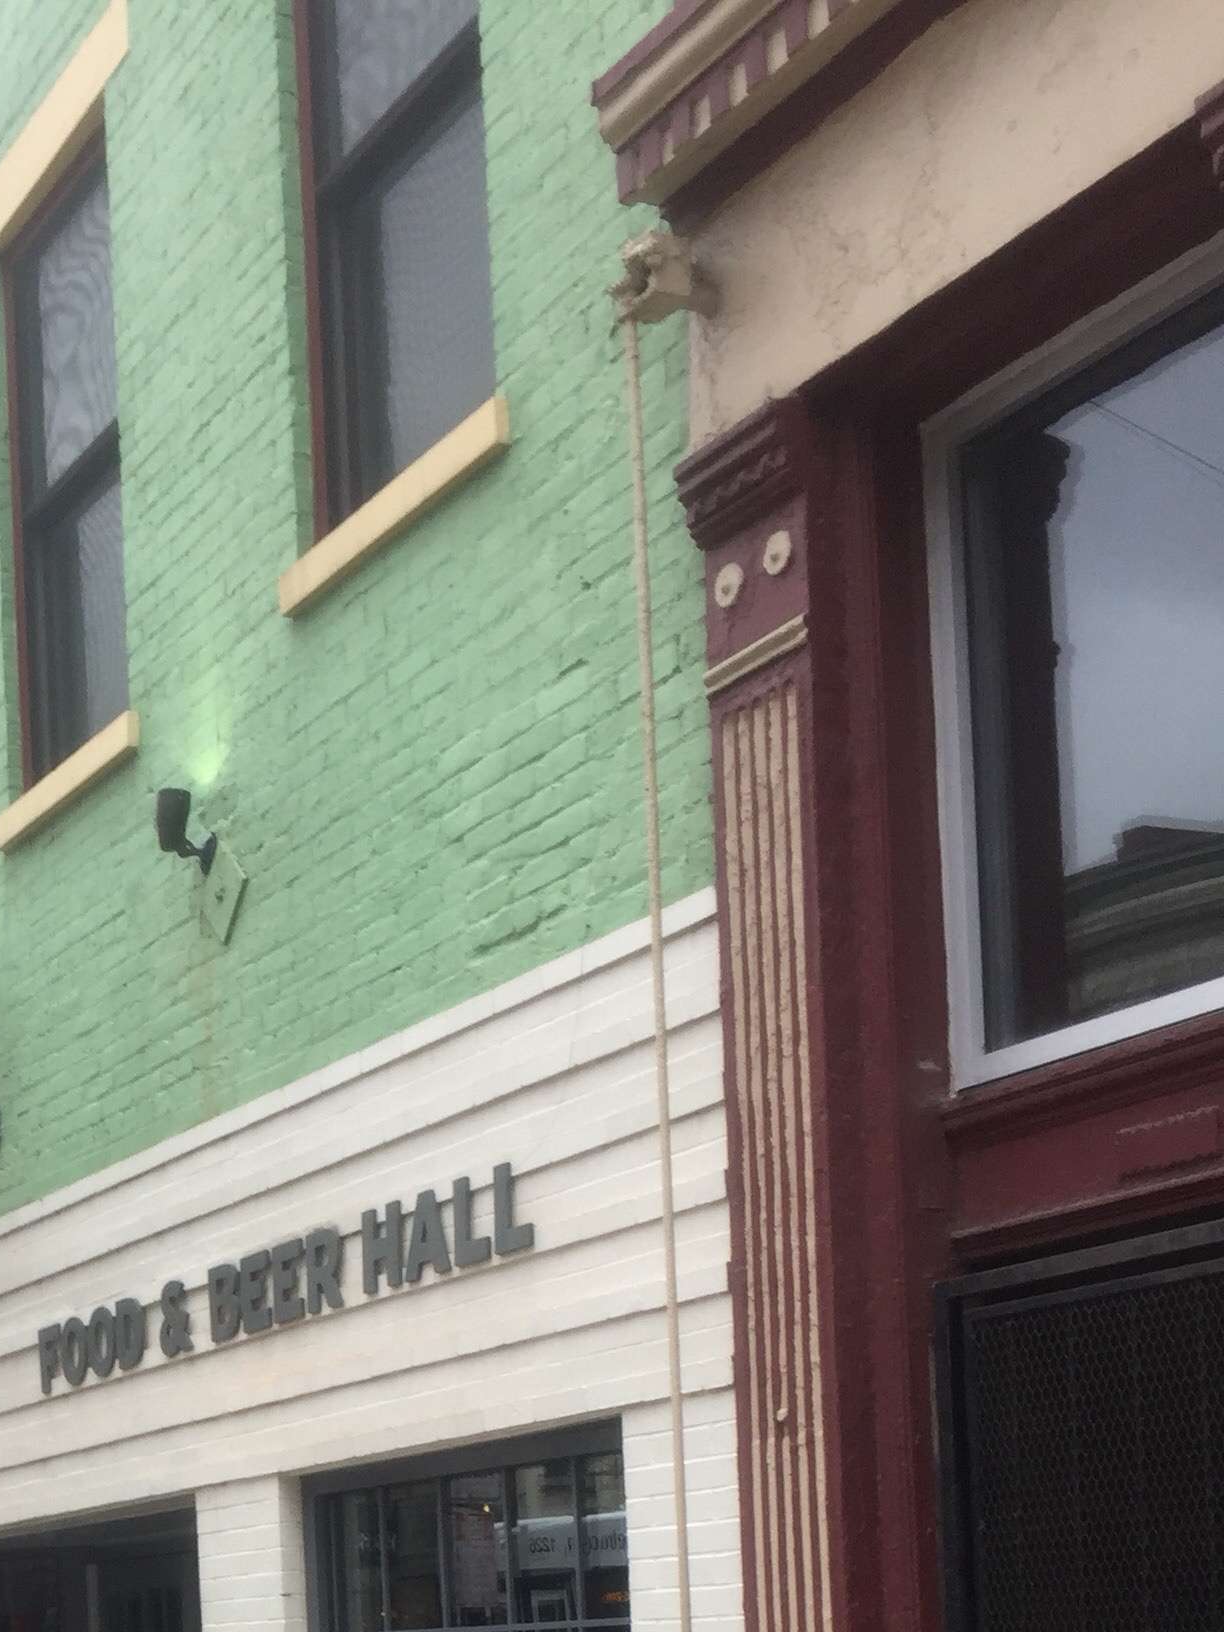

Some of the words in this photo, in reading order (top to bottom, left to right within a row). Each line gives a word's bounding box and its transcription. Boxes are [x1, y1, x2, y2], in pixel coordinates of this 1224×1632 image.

[38, 1298, 146, 1395] FOOD
[159, 1280, 195, 1359] &
[208, 1228, 345, 1344] BEER
[362, 1161, 535, 1296] HALL
